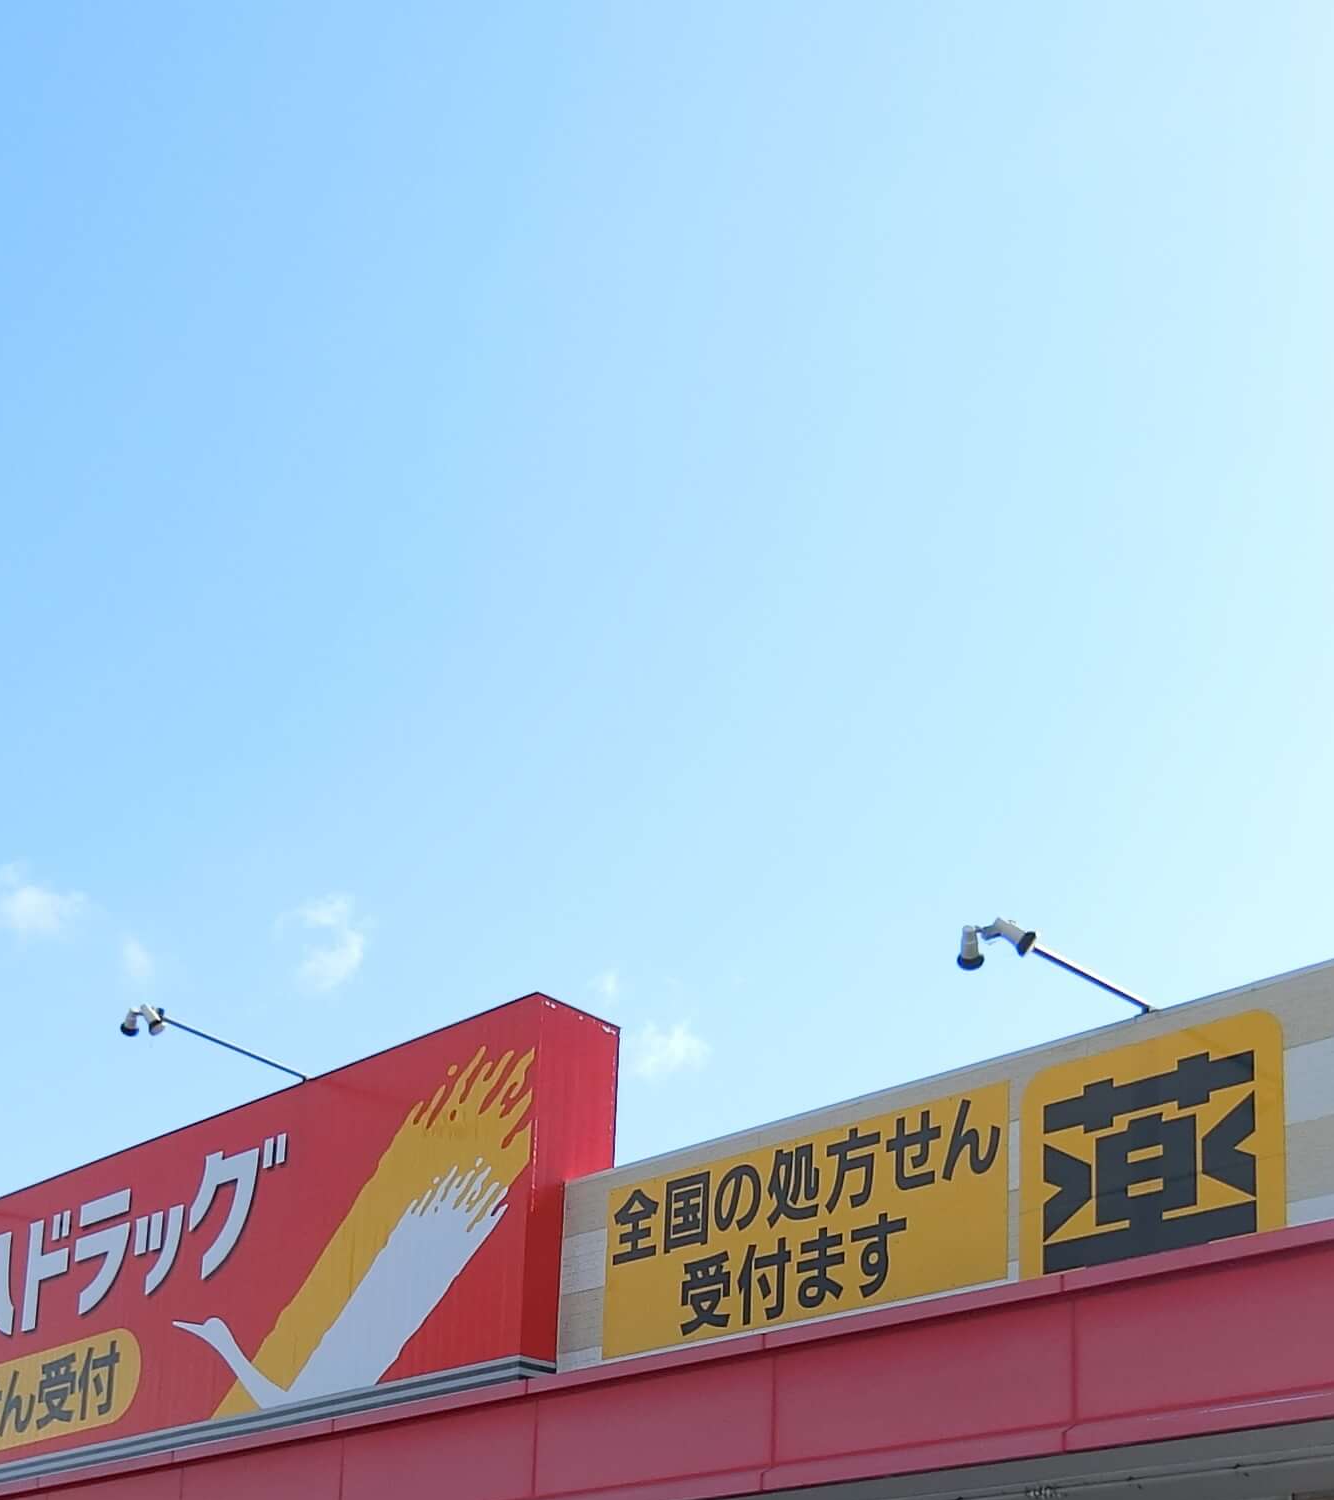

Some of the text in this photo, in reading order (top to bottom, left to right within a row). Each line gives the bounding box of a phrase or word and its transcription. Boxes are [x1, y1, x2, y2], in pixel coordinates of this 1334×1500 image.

[611, 1099, 1002, 1267] 全国の処方せん
[679, 1212, 908, 1336] 受付ます
